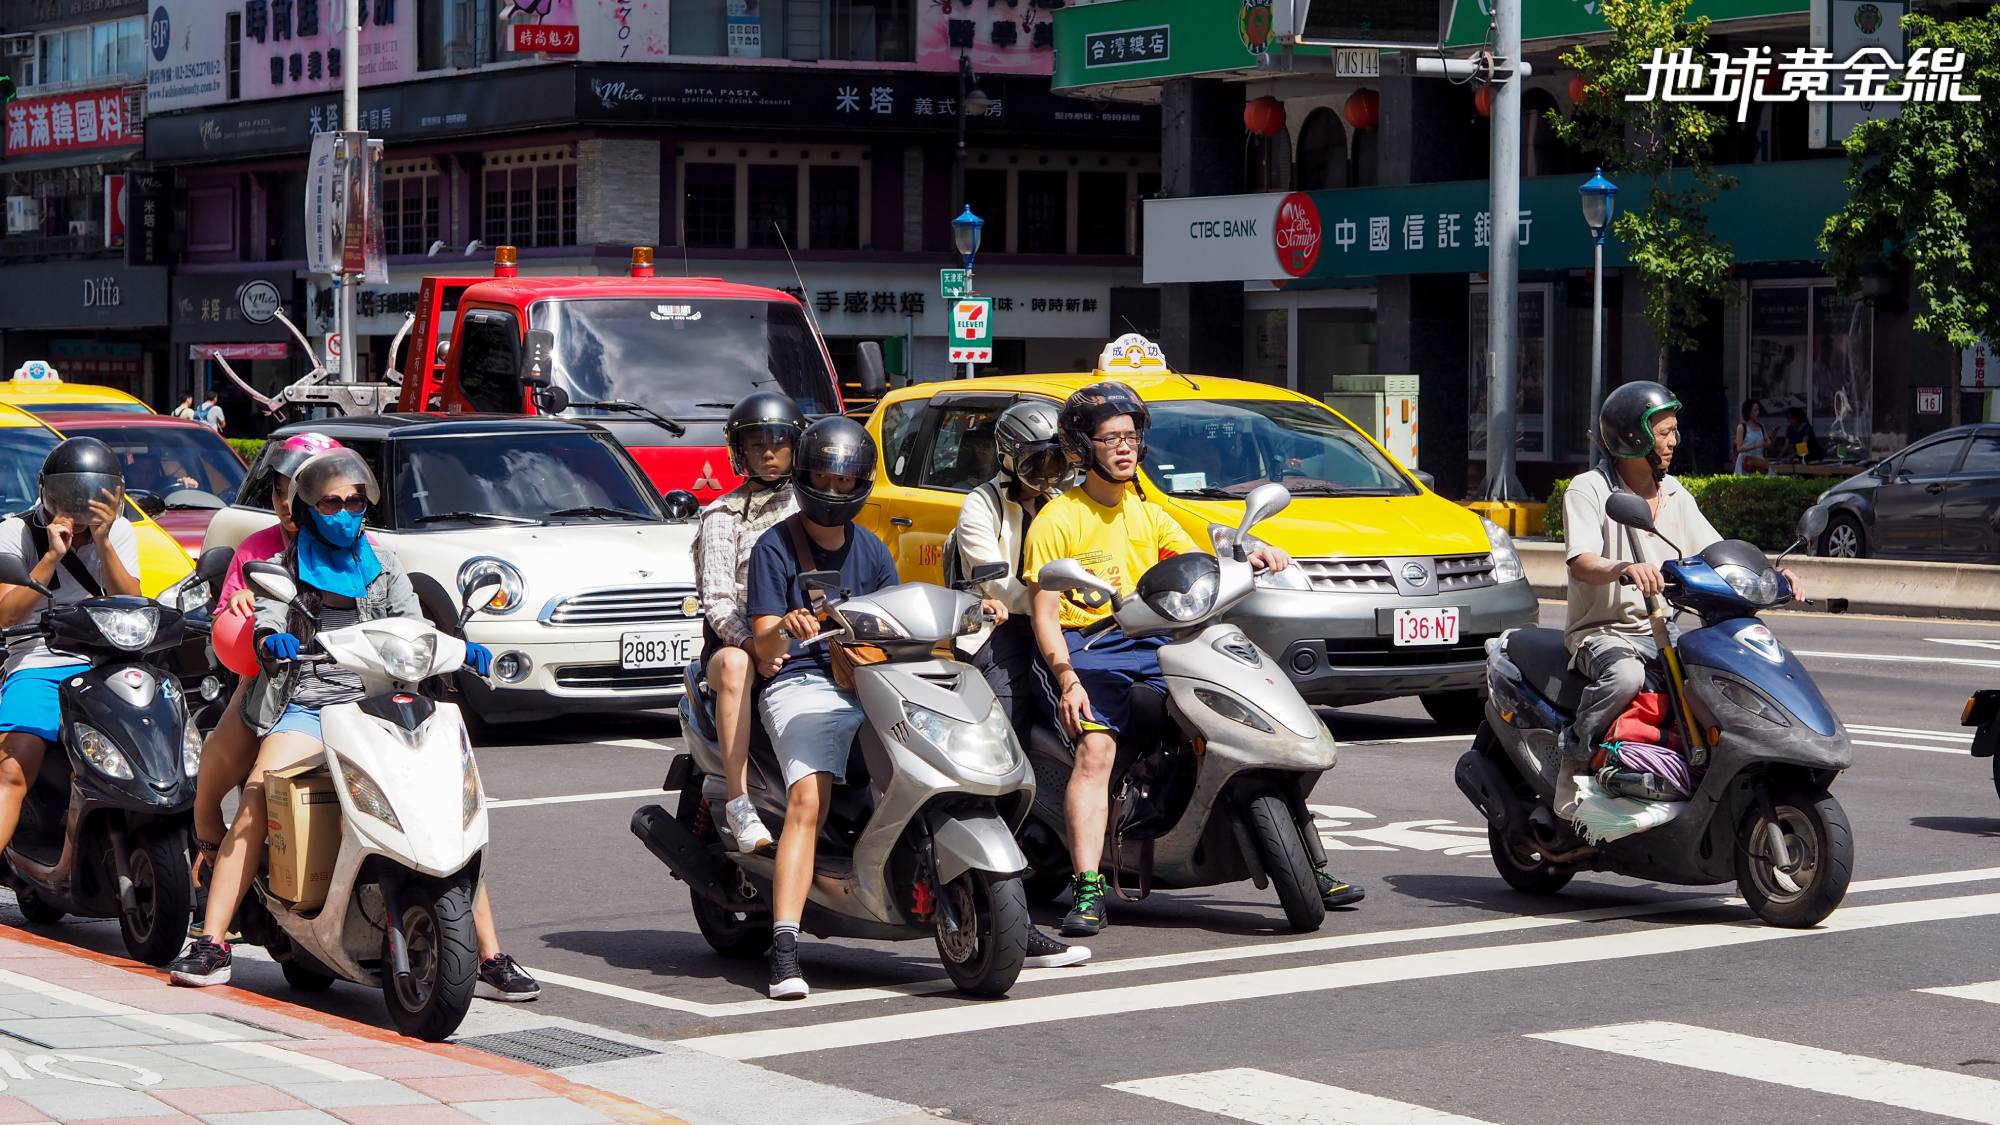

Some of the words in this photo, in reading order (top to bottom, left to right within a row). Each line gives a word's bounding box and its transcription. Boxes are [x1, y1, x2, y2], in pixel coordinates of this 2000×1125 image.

[153, 20, 168, 48] 3F
[519, 28, 575, 46] 時尚魅力
[617, 0, 632, 58] 701
[1337, 51, 1379, 74] CMS144
[600, 81, 648, 106] Mita
[685, 88, 712, 96] MITA
[721, 89, 758, 97] PASTA
[836, 87, 894, 115] 米塔
[914, 97, 1002, 117] 義式房
[310, 103, 338, 134] 米塔
[359, 107, 392, 130] 式廚房
[1190, 221, 1219, 239] CTBC
[1223, 219, 1257, 237] BANK
[83, 278, 120, 307] Diffa
[815, 290, 926, 315] 手感烘焙
[1925, 398, 1936, 410] 16
[919, 543, 945, 566] 136-
